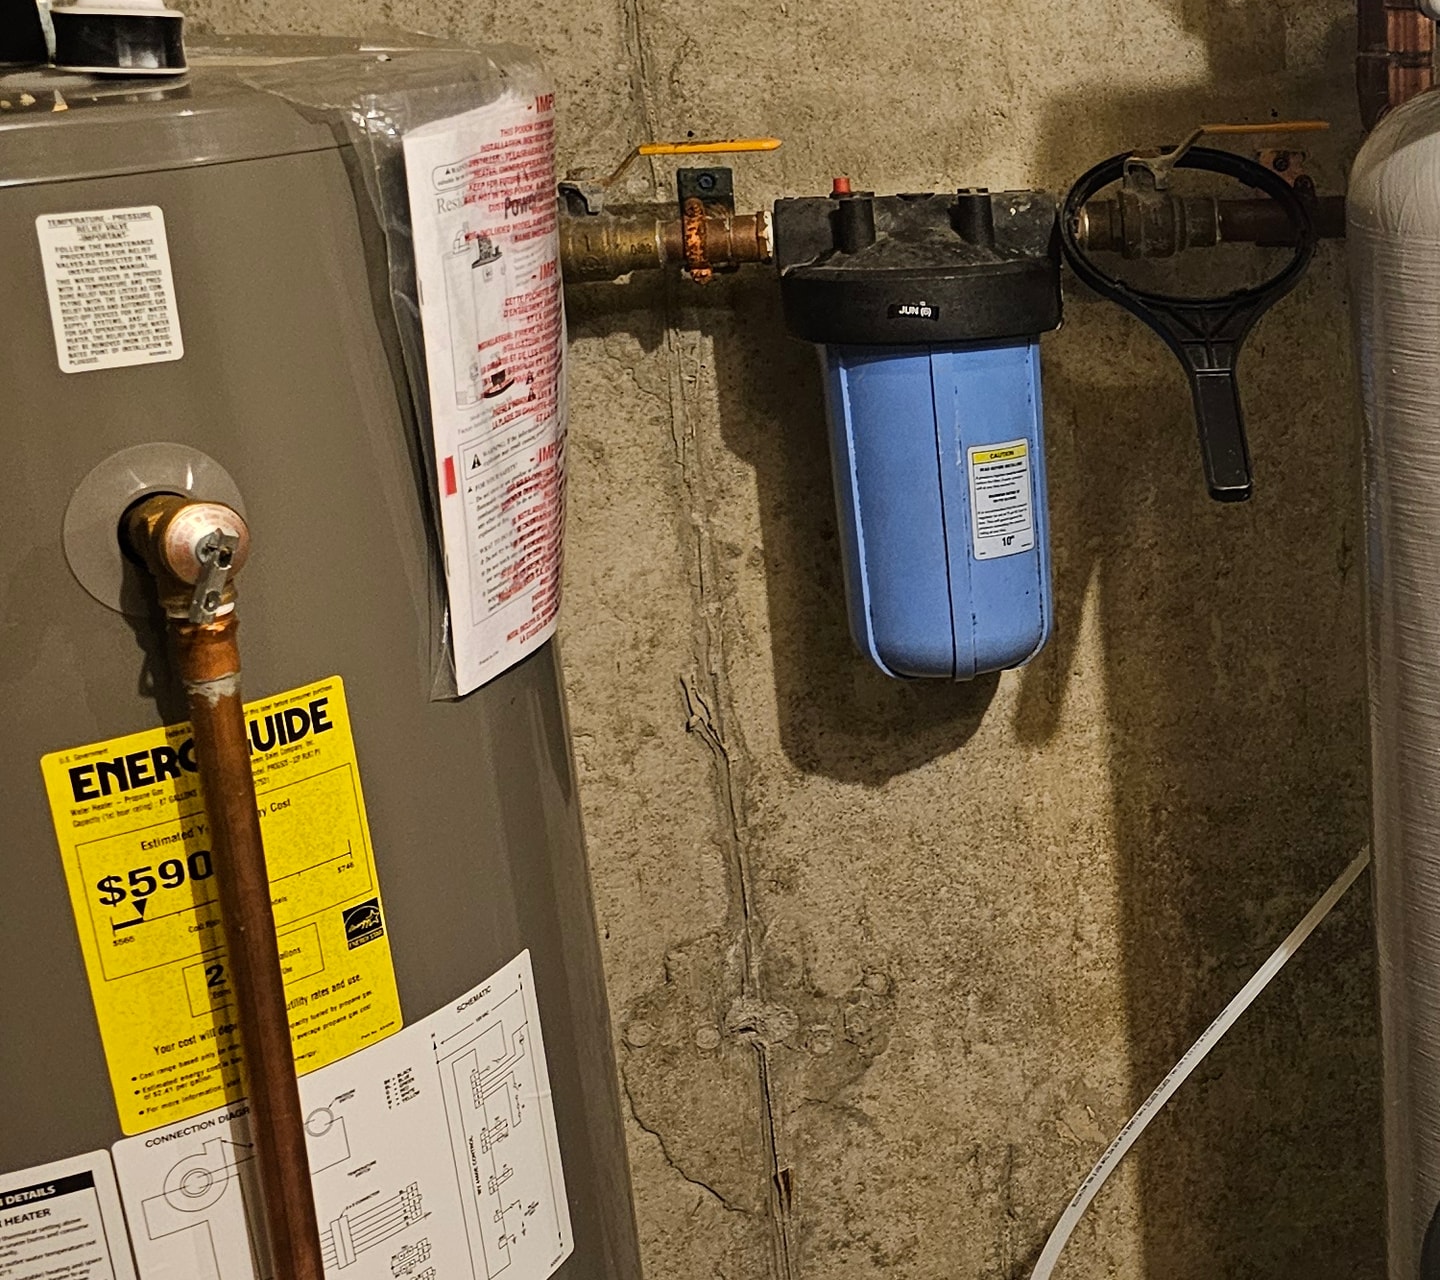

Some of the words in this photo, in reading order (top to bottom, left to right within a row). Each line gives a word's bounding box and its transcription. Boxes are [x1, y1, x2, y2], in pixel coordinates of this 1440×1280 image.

[990, 451, 1014, 459] CAUTION
[1002, 535, 1015, 546] 10"
[74, 748, 107, 760] Government
[124, 792, 149, 802] Propane
[151, 788, 163, 796] Gas
[270, 798, 290, 812] Cost
[140, 829, 193, 850] Estimated
[98, 852, 214, 905] $590
[311, 987, 329, 1000] rates
[331, 979, 345, 992] and
[456, 985, 492, 1013] SCHEMATIC
[310, 1008, 328, 1019] fueled
[153, 1043, 174, 1054] Your
[178, 1035, 196, 1048] cost
[199, 1028, 215, 1040] will
[156, 1064, 176, 1073] range
[142, 1078, 177, 1093] Estimated
[145, 1116, 216, 1149] CONNECTION
[217, 1105, 251, 1125] DIAGR
[5, 1185, 55, 1204] DETAILS
[4, 1208, 50, 1225] HEATER
